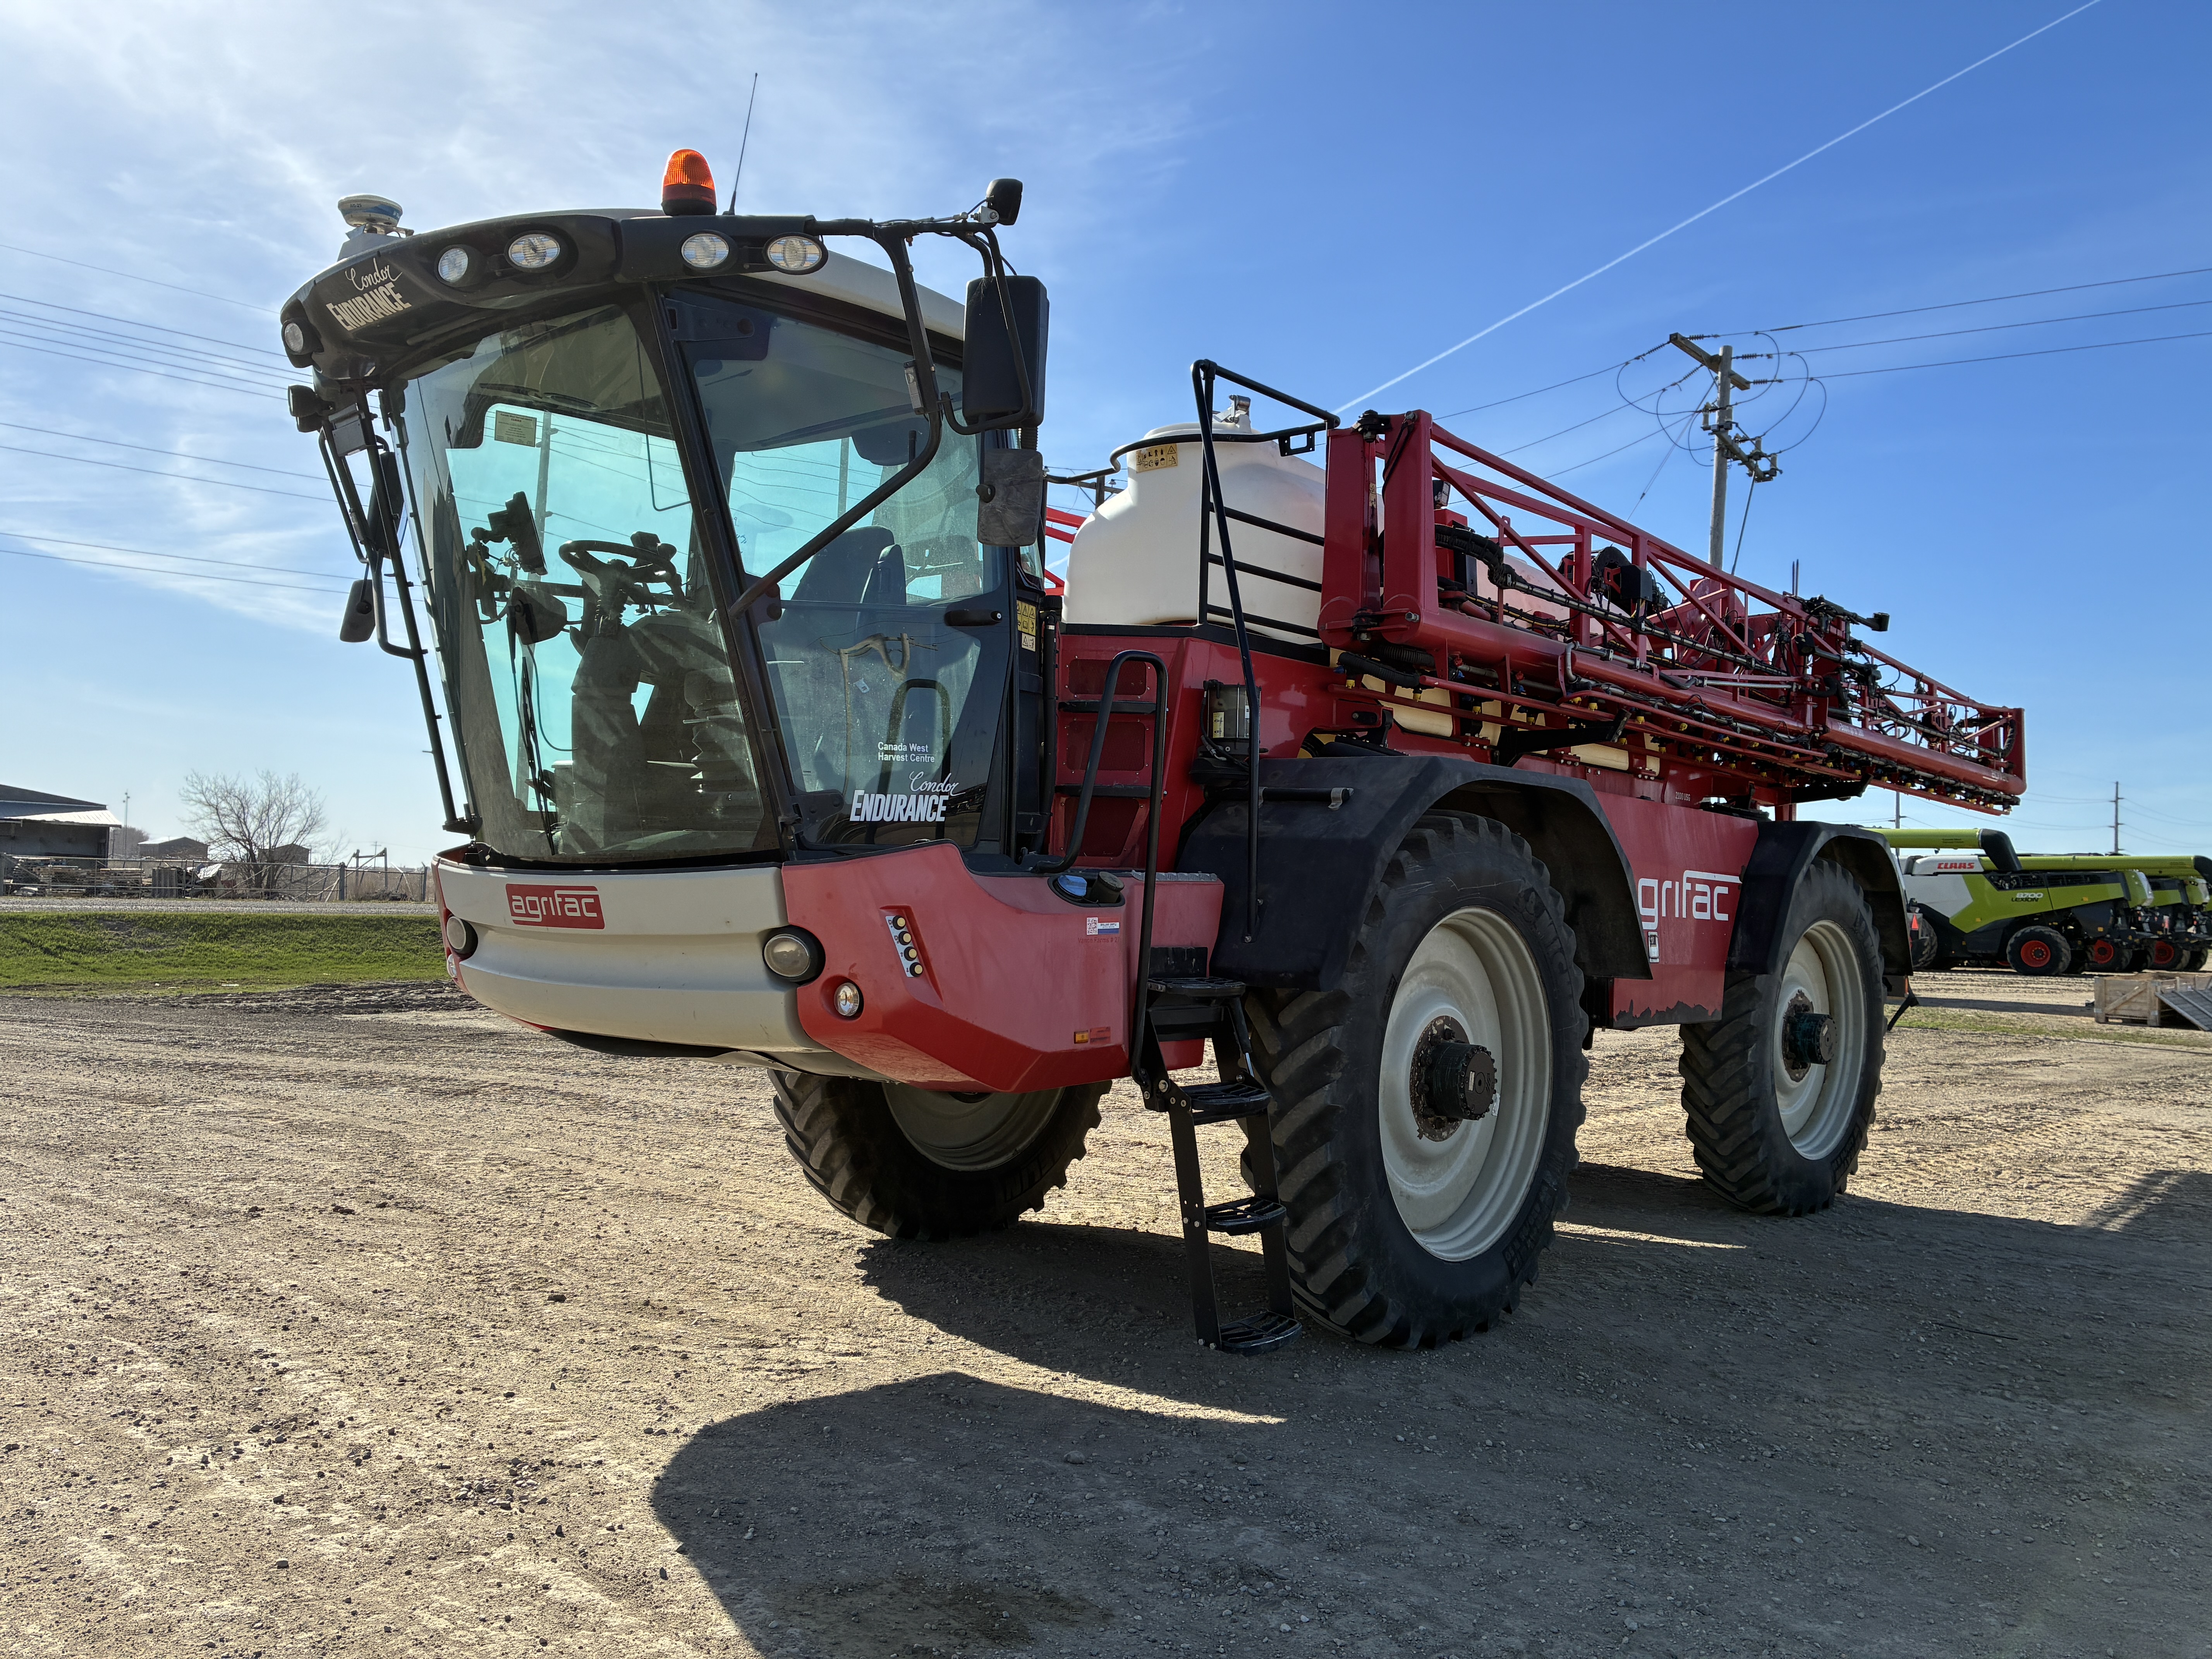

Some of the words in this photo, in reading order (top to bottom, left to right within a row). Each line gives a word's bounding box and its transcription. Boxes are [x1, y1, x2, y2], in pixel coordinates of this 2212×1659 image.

[345, 257, 403, 291] Condor
[326, 282, 412, 331] ENDURANCE
[878, 741, 907, 752] Canada
[909, 743, 929, 752] West
[878, 752, 908, 762] Harvest
[910, 753, 935, 763] Centre
[909, 771, 966, 797] Condor
[849, 790, 949, 822] ENDURANCE
[511, 890, 599, 922] agrifac
[1638, 870, 1742, 930] grifac
